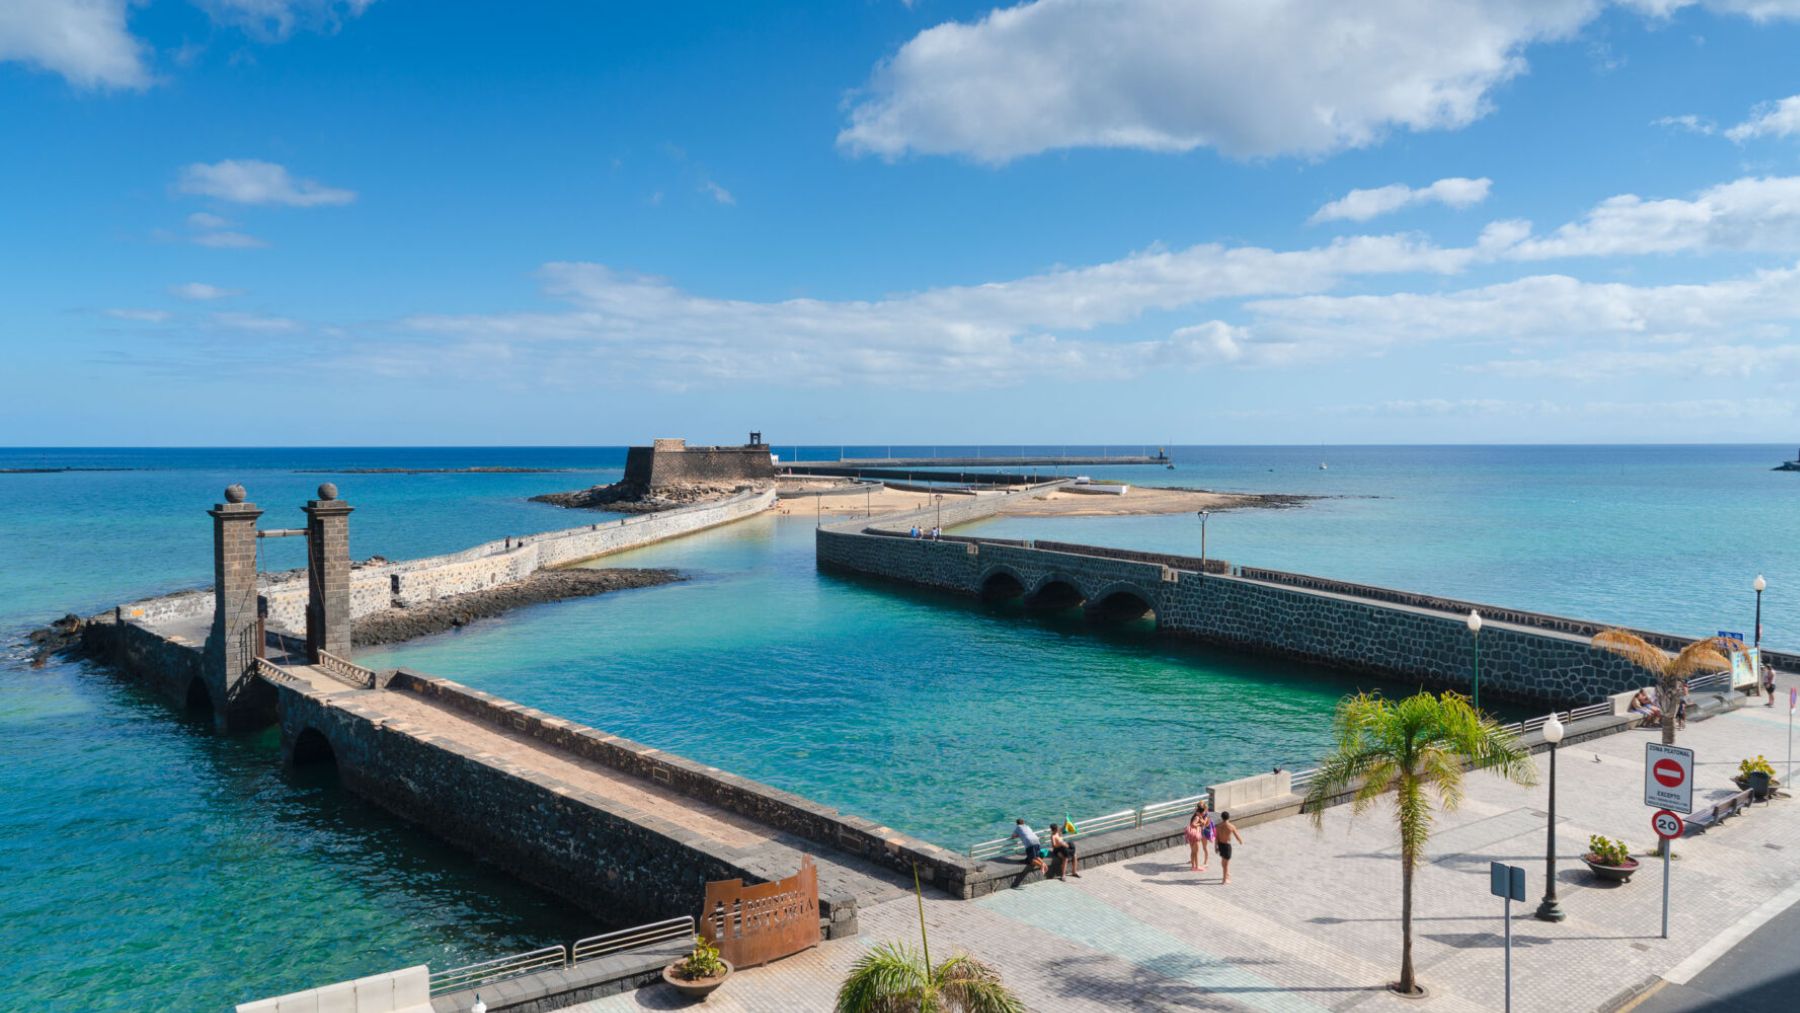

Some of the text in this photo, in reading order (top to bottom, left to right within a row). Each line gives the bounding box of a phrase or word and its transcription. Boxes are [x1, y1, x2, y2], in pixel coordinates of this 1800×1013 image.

[1649, 744, 1689, 756] ZONA PEATONAL
[1657, 791, 1680, 799] EXCEPTO
[1658, 819, 1677, 831] 20
